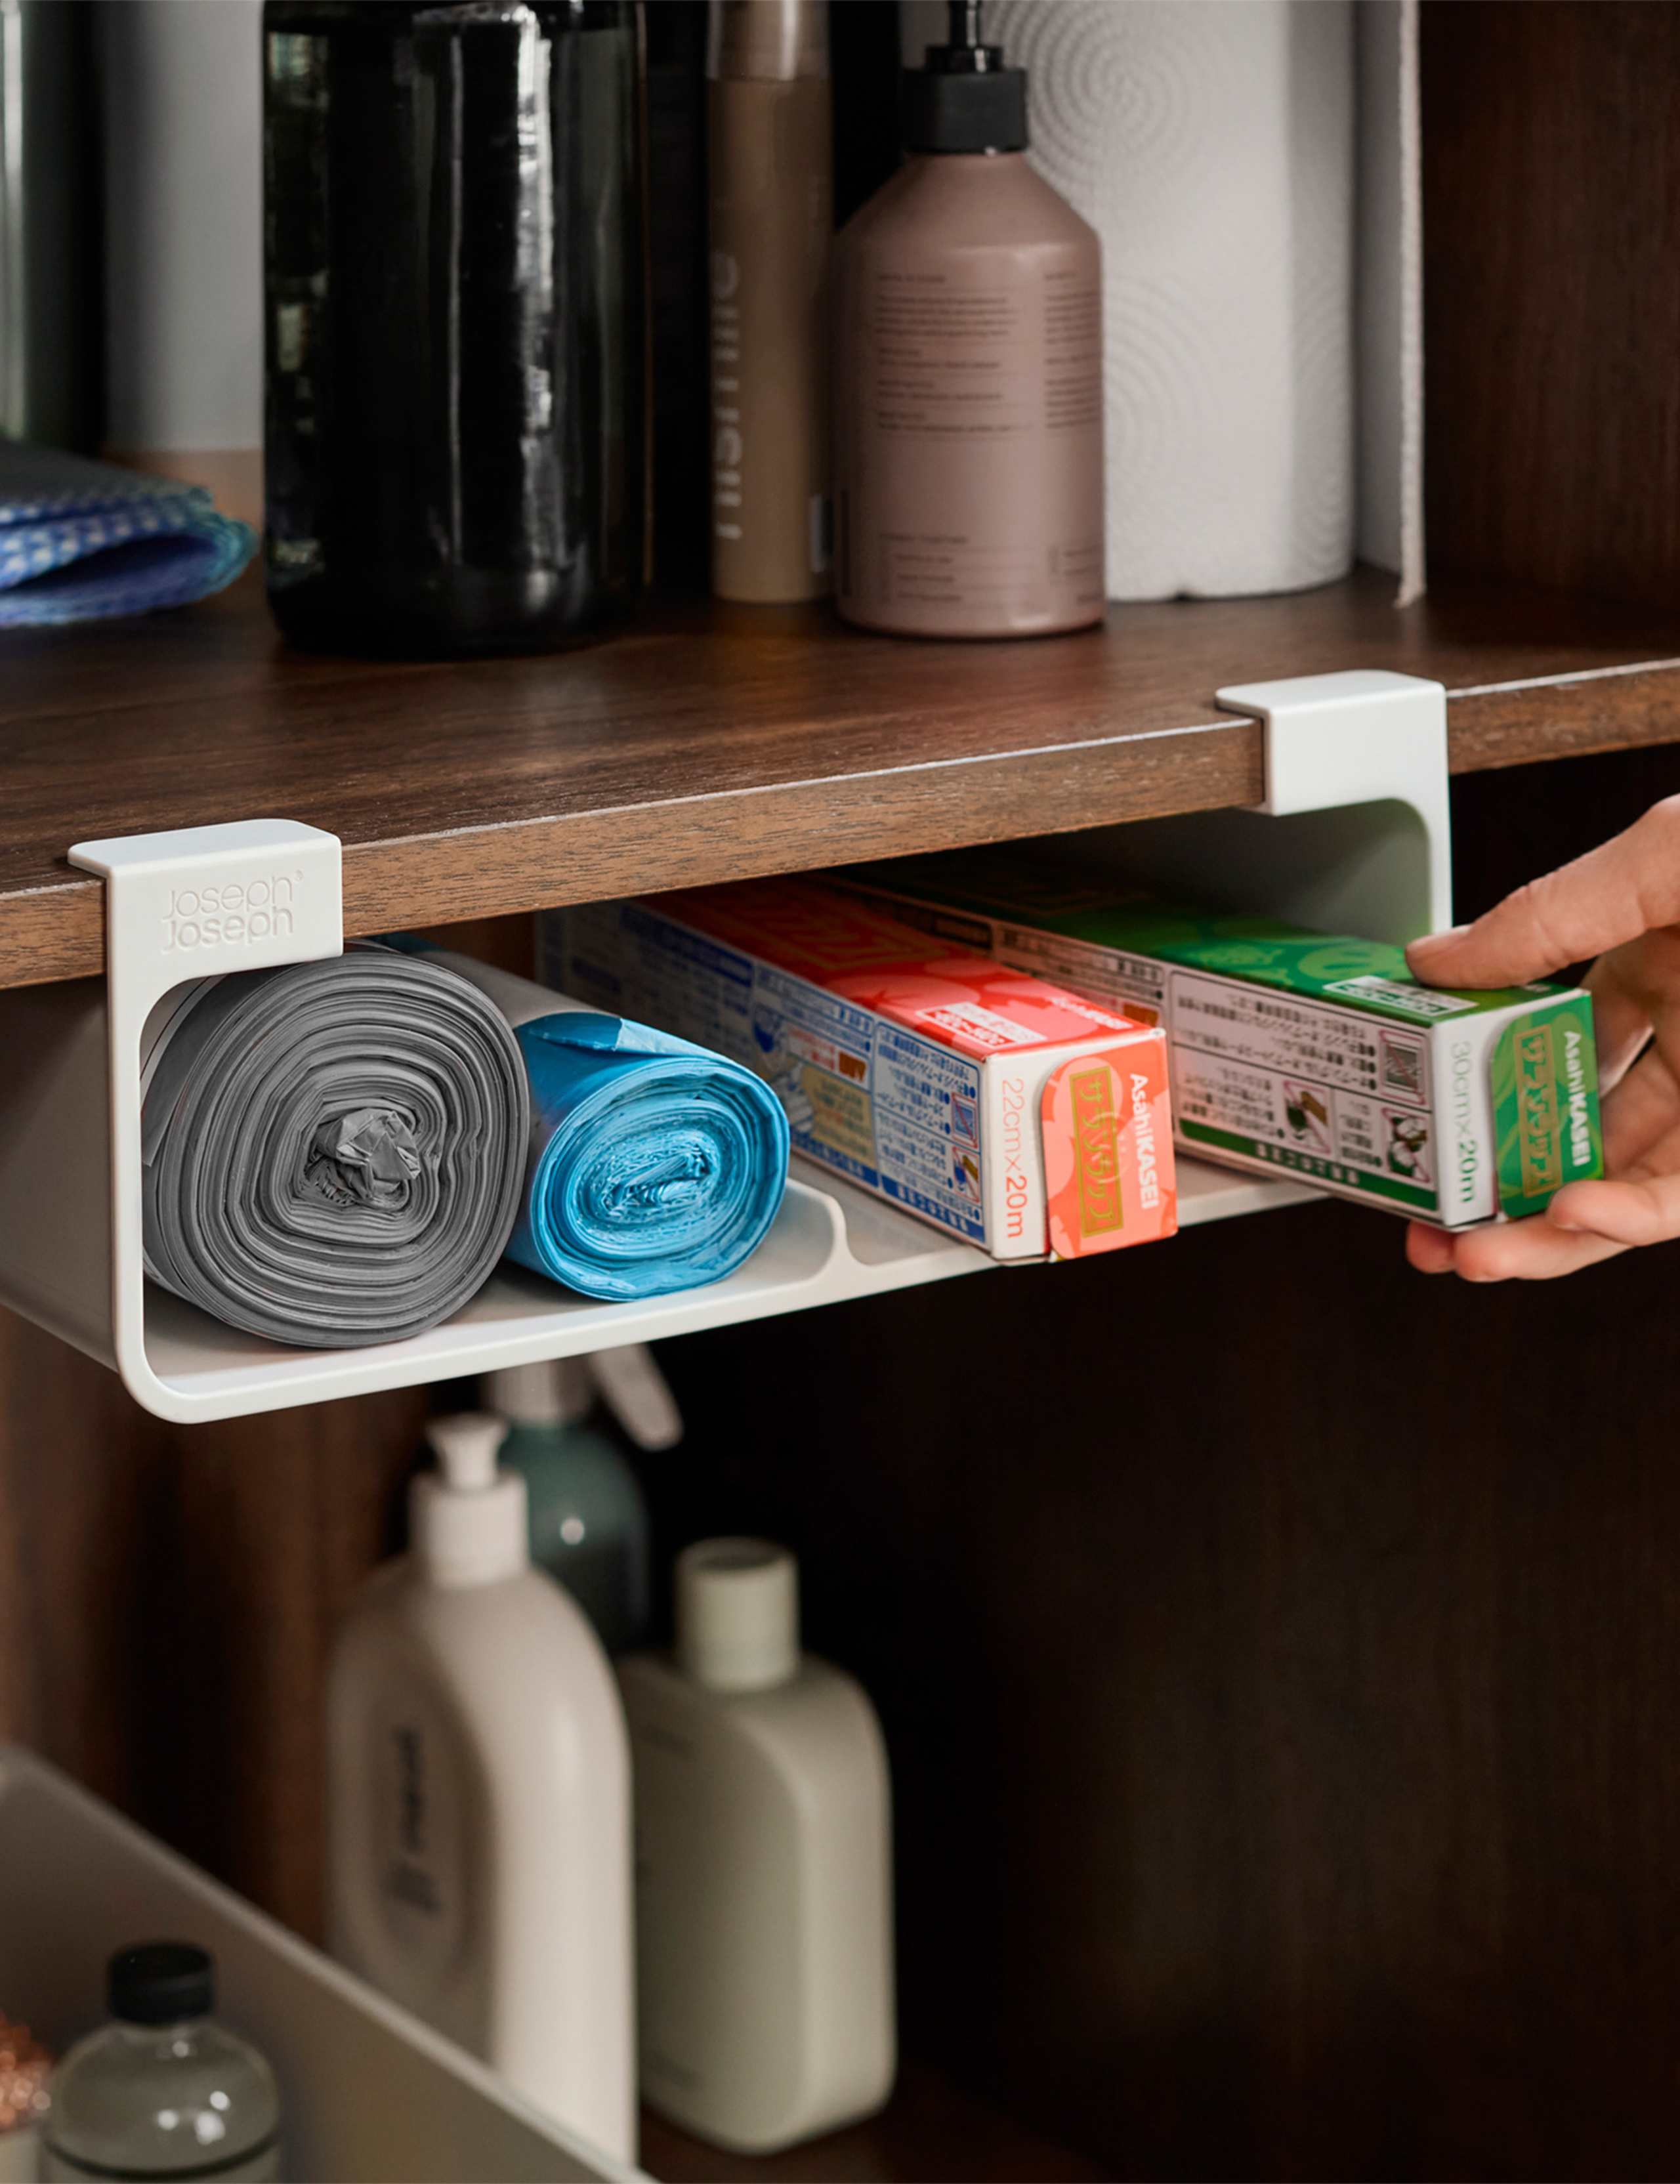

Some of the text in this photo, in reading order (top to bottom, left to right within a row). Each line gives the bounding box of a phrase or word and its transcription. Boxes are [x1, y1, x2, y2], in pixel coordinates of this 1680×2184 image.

[161, 906, 294, 954] Joseph
[1079, 1078, 1115, 1220] サランラップ
[1129, 1073, 1159, 1210] AsahiKASEI
[1564, 1030, 1591, 1167] AsahiKASEI
